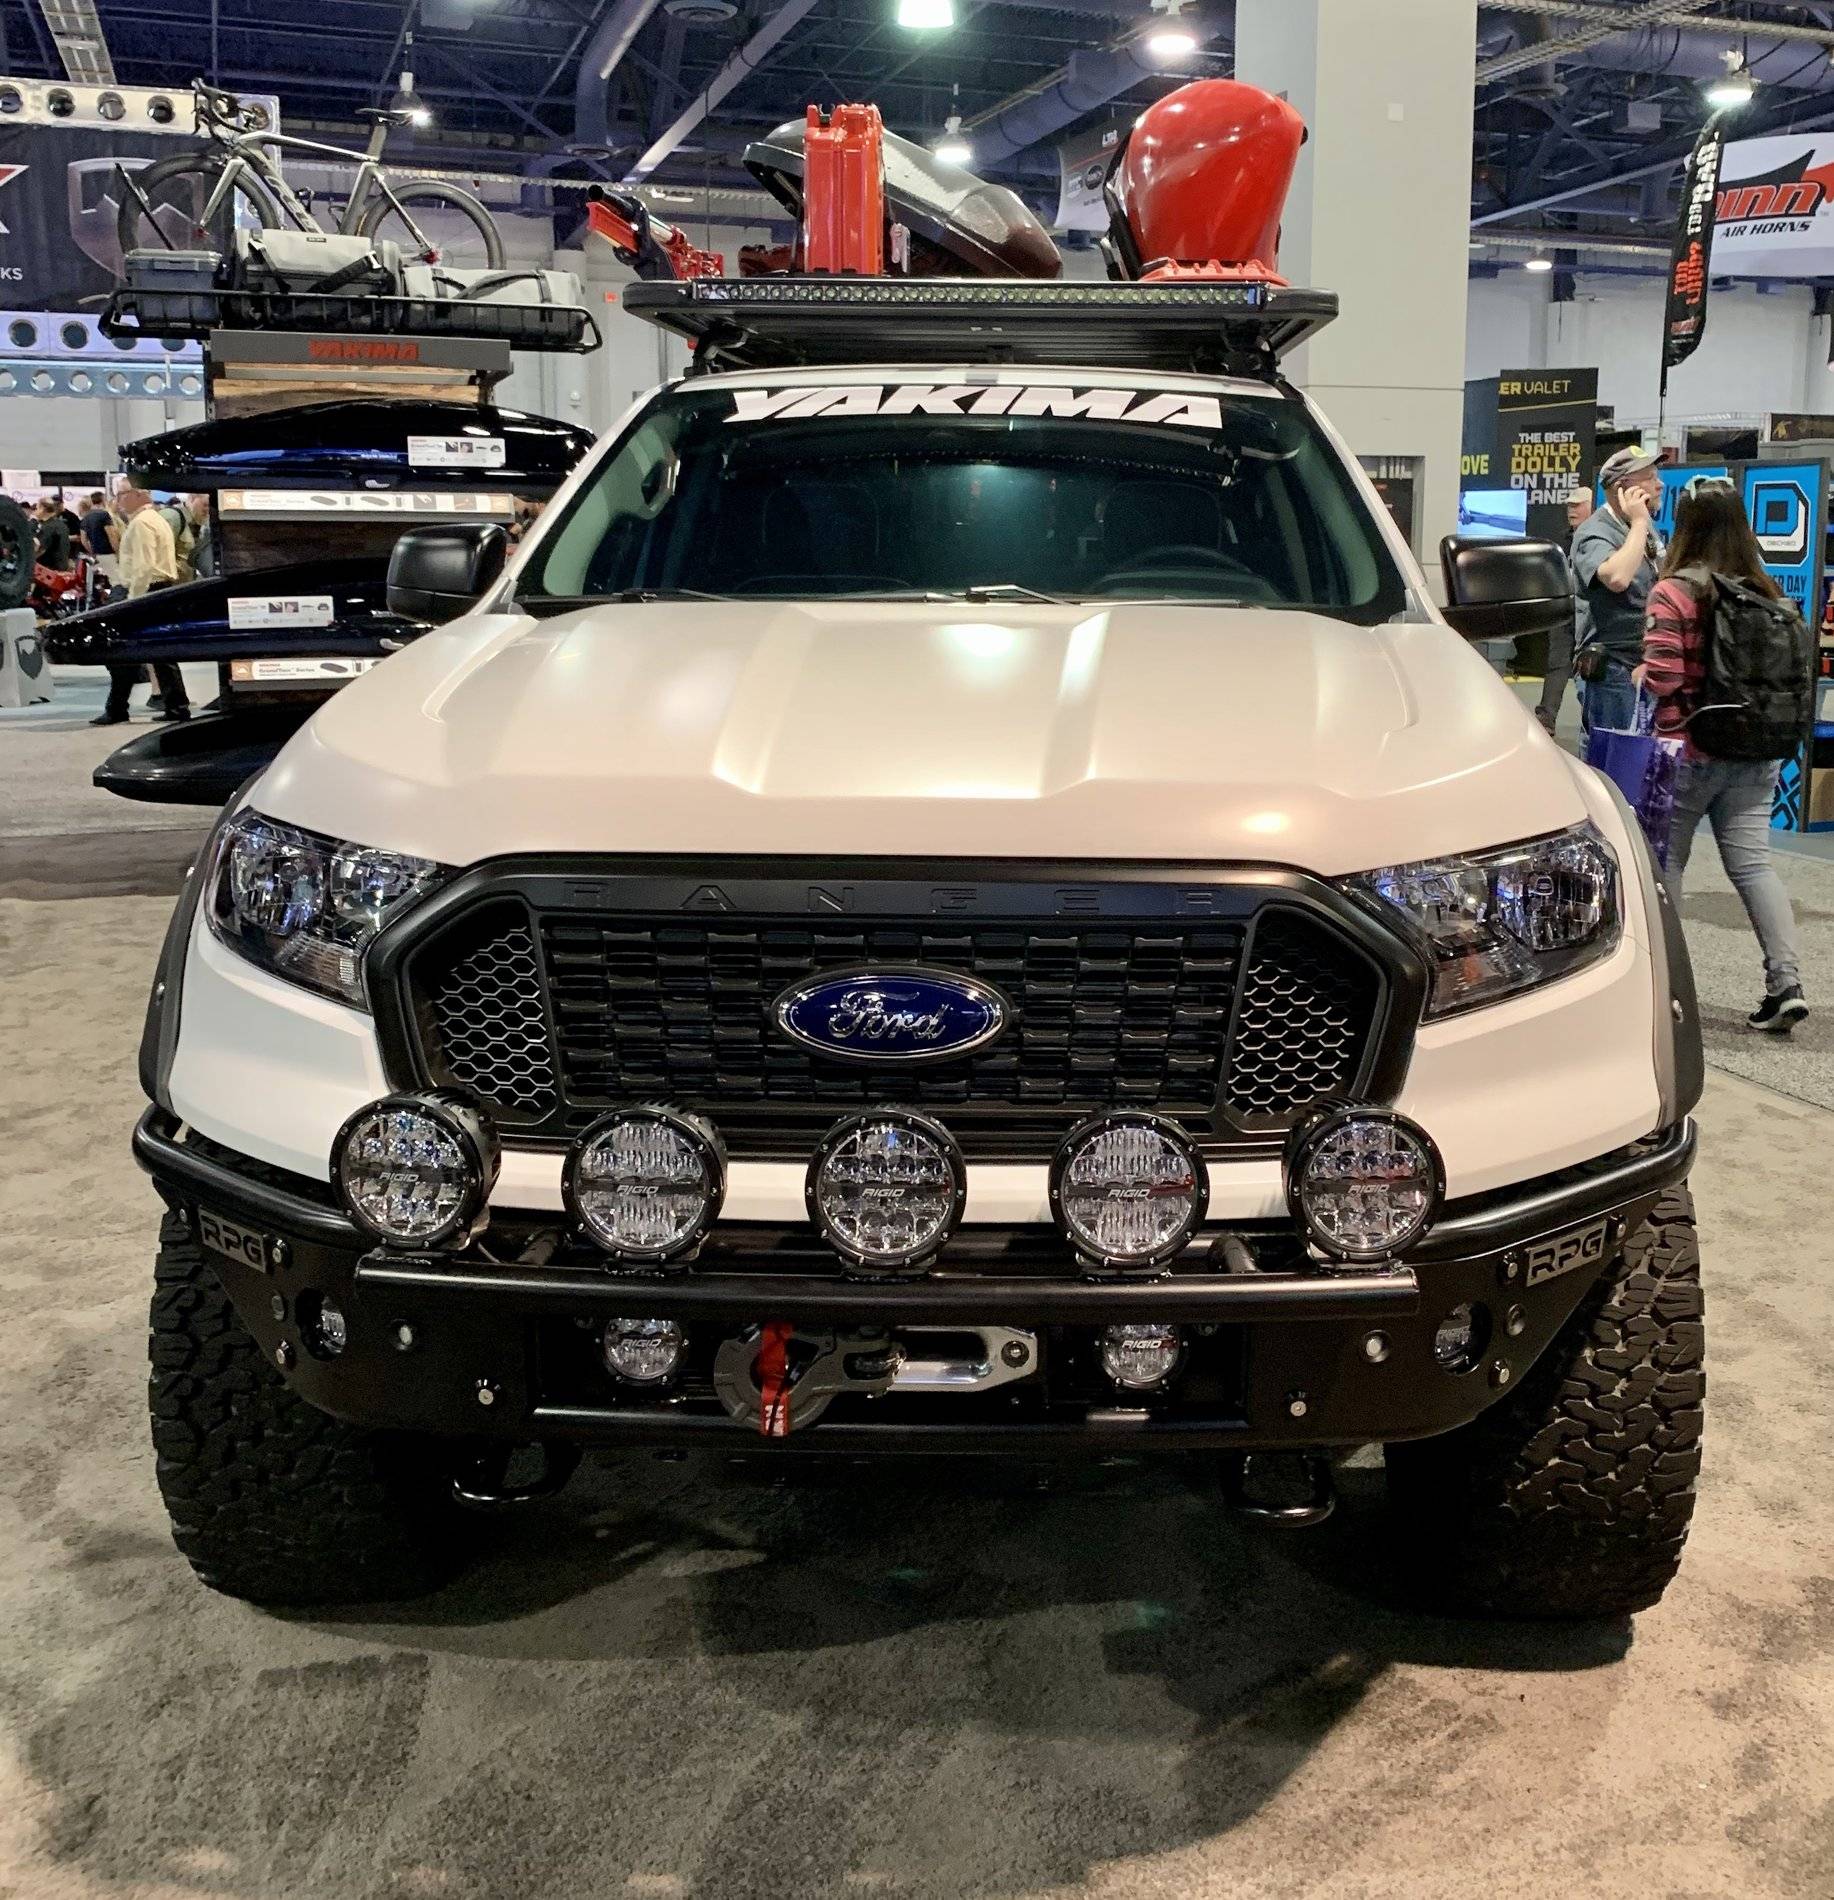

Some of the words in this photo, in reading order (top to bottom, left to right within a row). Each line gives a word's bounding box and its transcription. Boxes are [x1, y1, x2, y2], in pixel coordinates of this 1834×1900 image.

[1721, 226, 1748, 238] AIR
[1750, 221, 1812, 236] HORNS
[1524, 380, 1571, 395] VALET
[722, 385, 1223, 429] YAKIMA
[1519, 433, 1541, 443] THE
[1544, 431, 1576, 443] BEST
[1511, 442, 1582, 457] TRAILER
[1511, 456, 1582, 474] DOLLY
[1510, 474, 1537, 489] ON
[1543, 472, 1580, 489] THE
[1786, 575, 1807, 593] DAY
[562, 879, 1222, 914] RANGER
[828, 990, 952, 1040] Ford
[379, 1171, 420, 1182] RIGID
[616, 1184, 659, 1194] RIGID
[861, 1187, 906, 1198] RIGID
[1107, 1188, 1151, 1198] RIGID
[1347, 1183, 1390, 1194] RIGID
[200, 1213, 263, 1266] RPG
[1530, 1227, 1604, 1279] RPG
[620, 1338, 662, 1348] RIGID
[1121, 1340, 1162, 1349] RIGID
